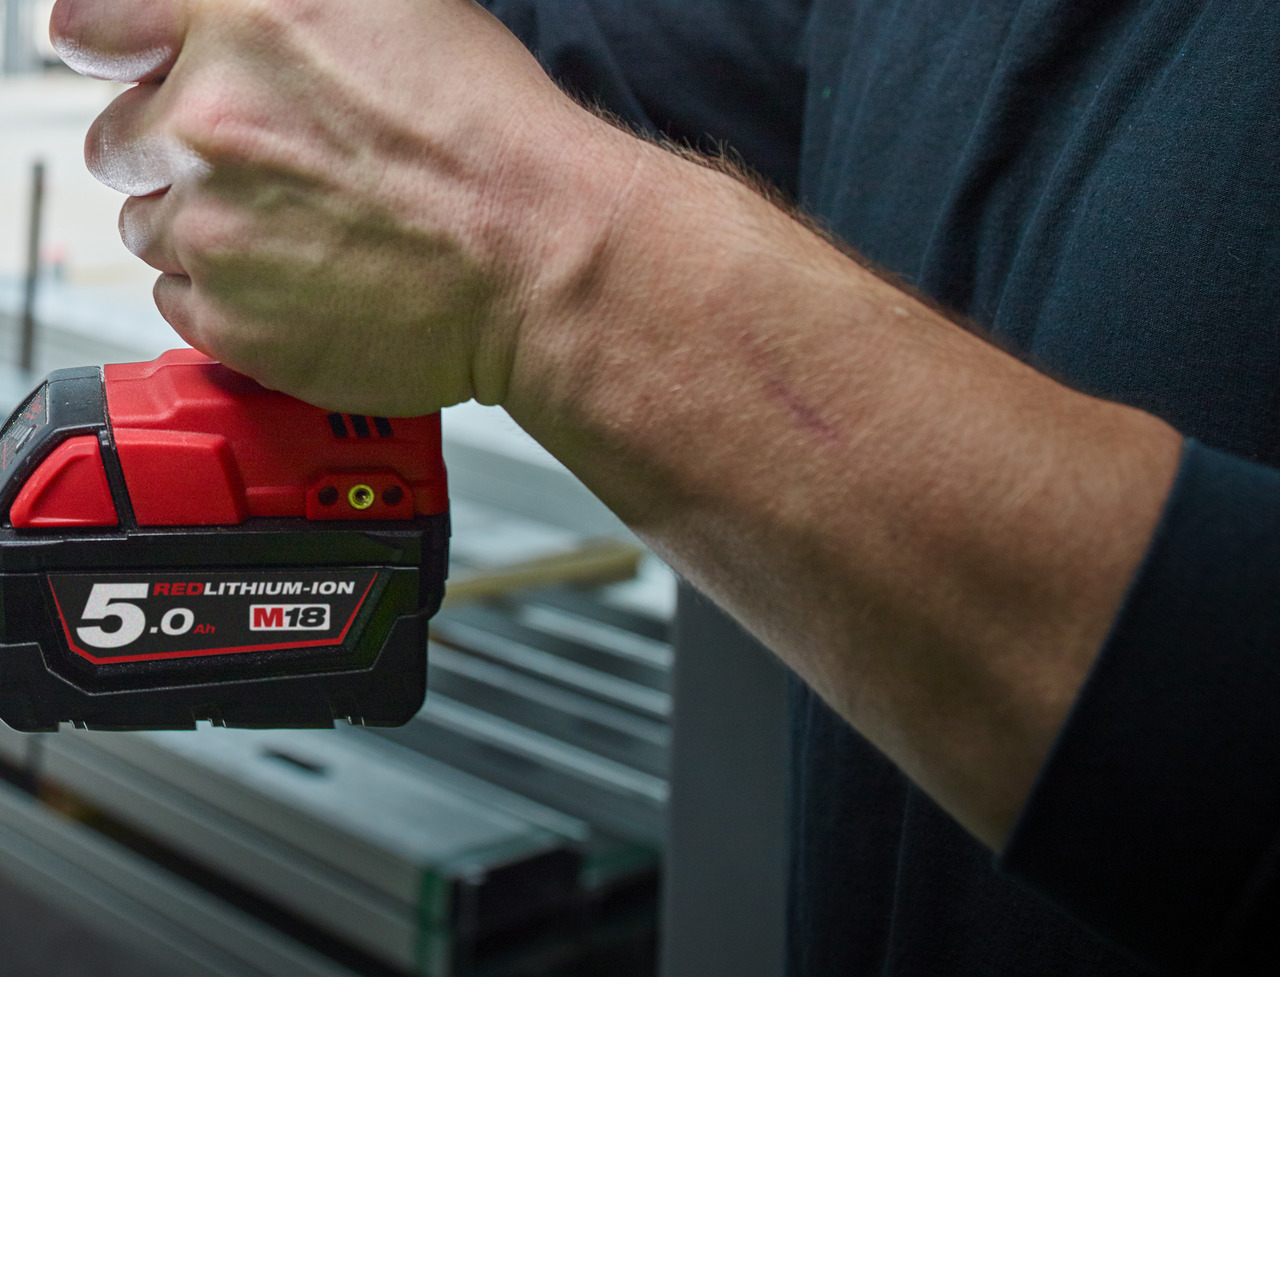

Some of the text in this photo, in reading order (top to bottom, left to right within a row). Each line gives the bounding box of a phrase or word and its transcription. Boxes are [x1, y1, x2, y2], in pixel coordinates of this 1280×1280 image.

[152, 581, 356, 597] REDLITHIUM-ION
[76, 582, 216, 649] 5.0 Ah
[252, 606, 327, 628] M18
